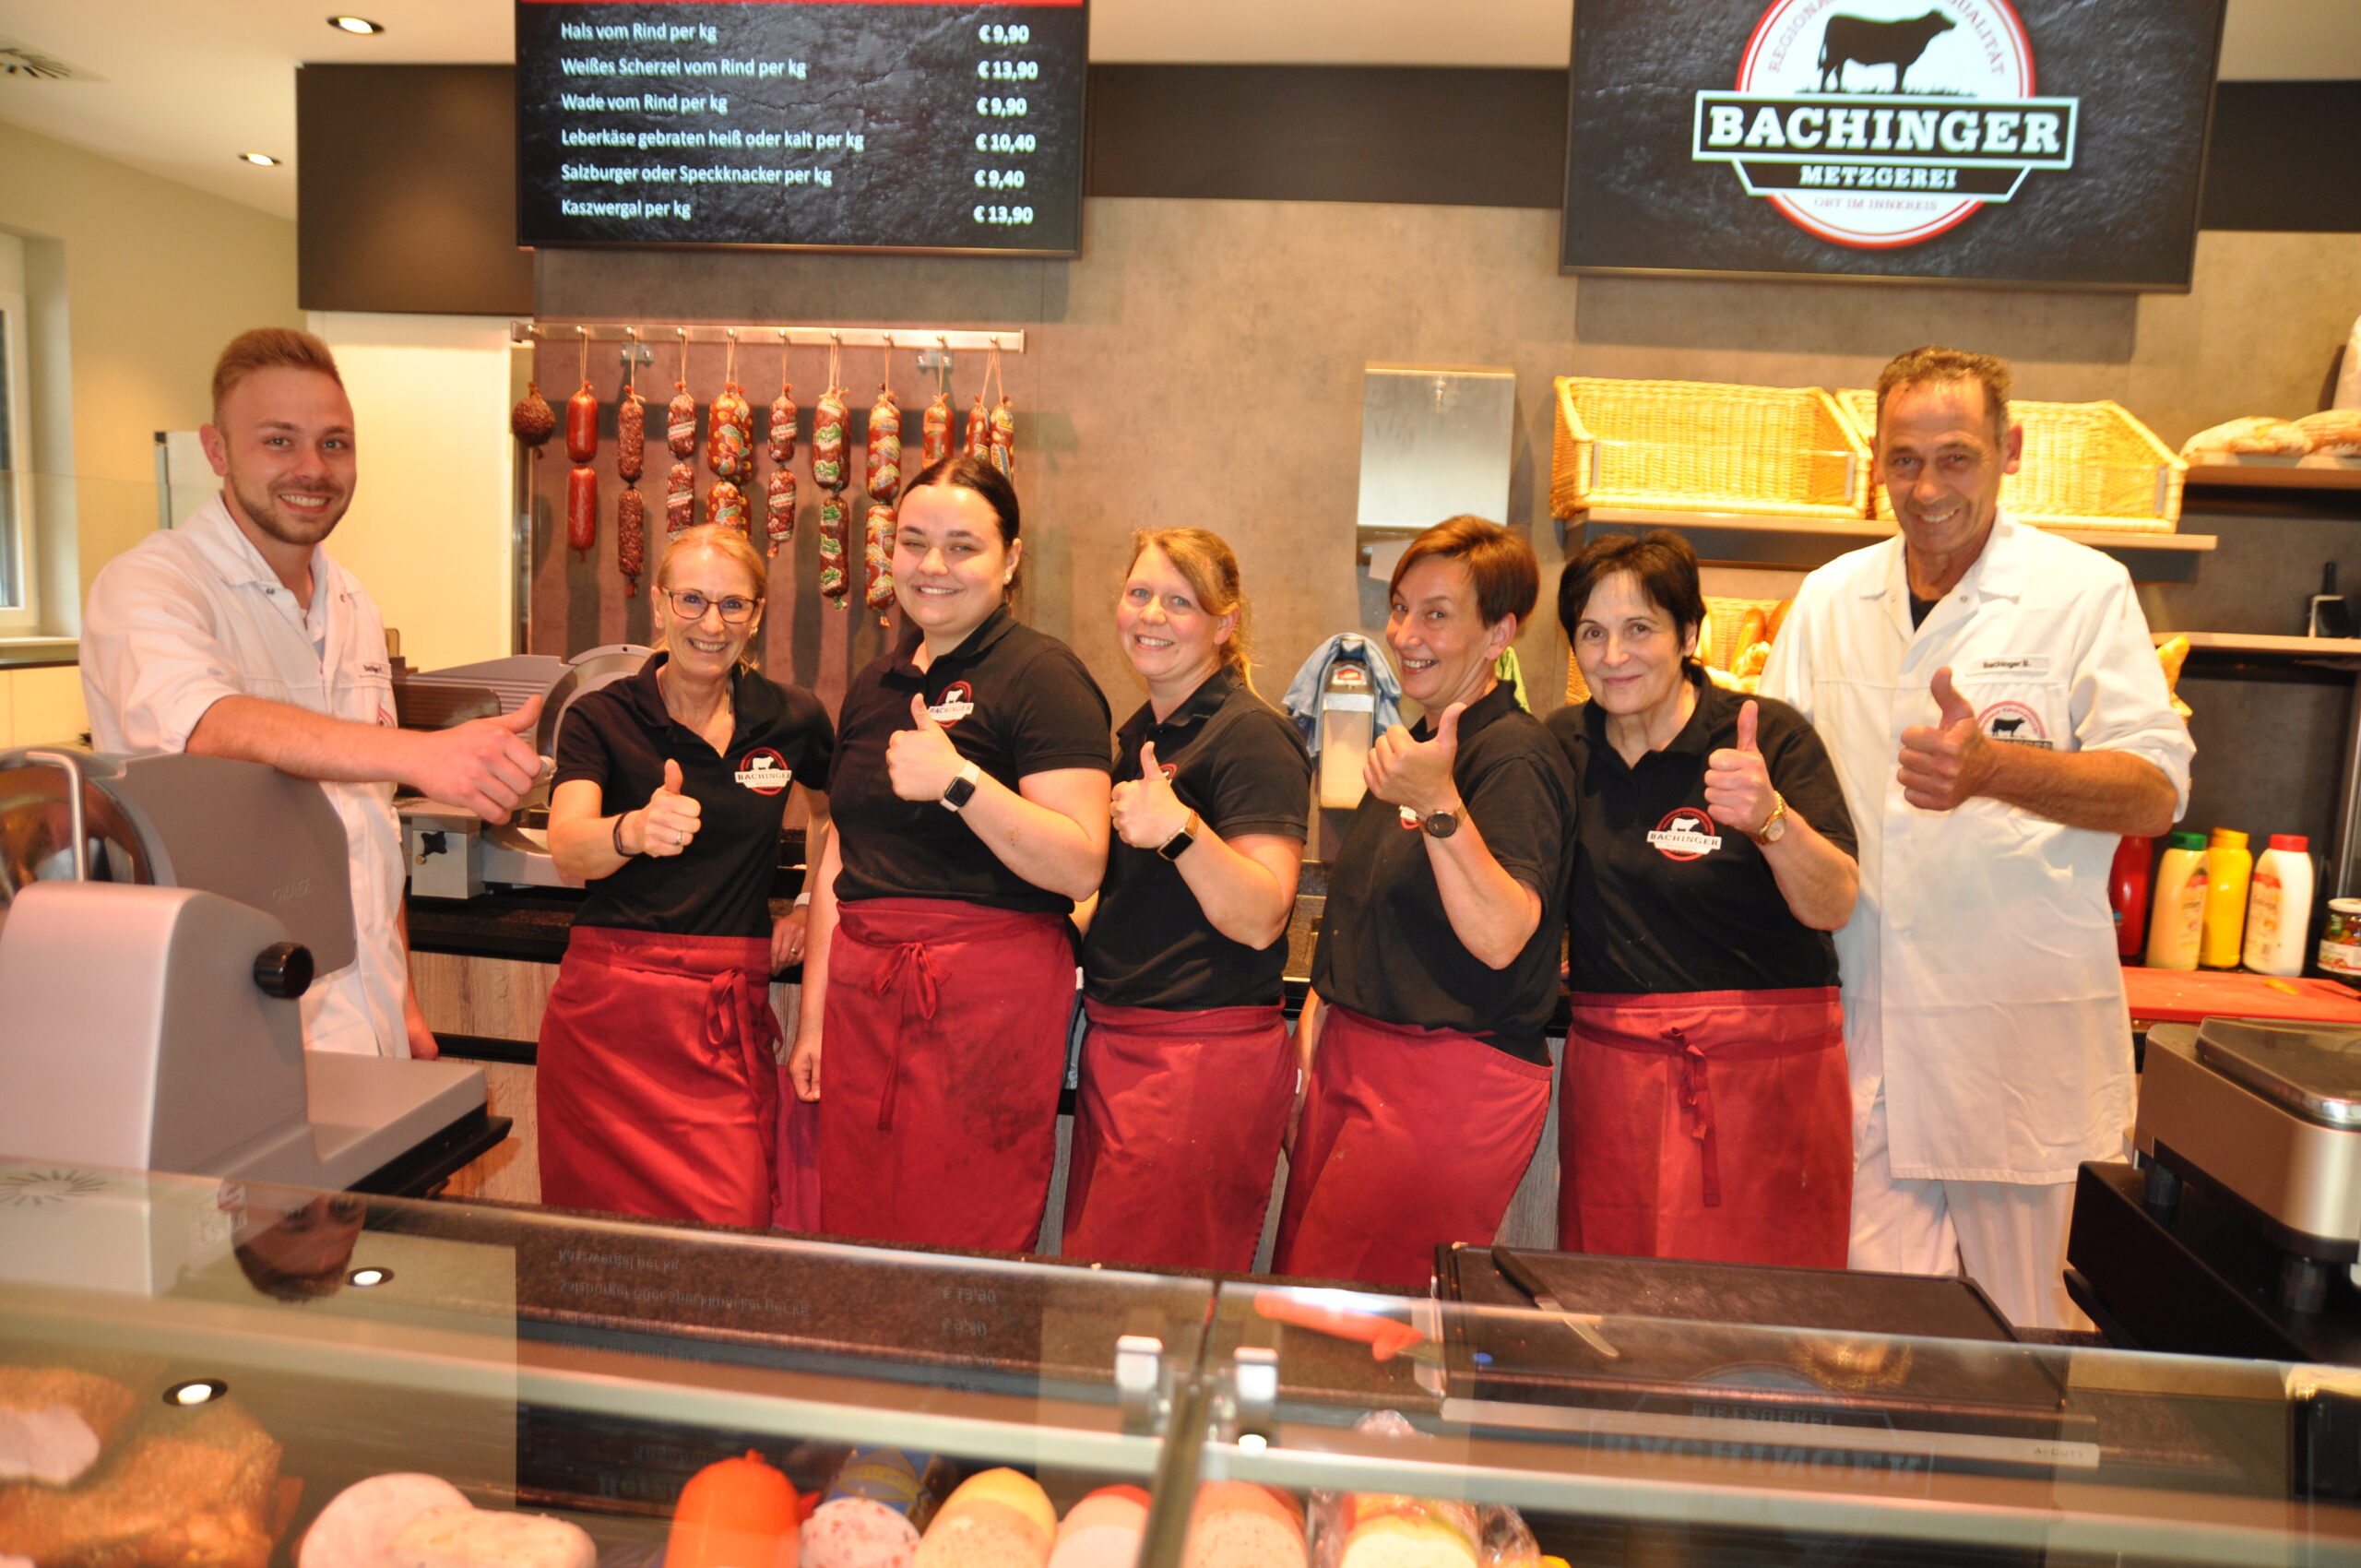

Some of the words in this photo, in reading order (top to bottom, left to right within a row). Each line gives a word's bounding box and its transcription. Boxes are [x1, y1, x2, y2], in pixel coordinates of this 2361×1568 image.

[561, 22, 593, 41] Hals
[596, 26, 629, 41] vom
[633, 22, 667, 41] Rind
[670, 25, 696, 44] per
[699, 22, 718, 44] kg
[979, 24, 991, 43] €
[992, 24, 1029, 46] 9,90
[561, 57, 616, 76] Weißes
[619, 58, 681, 76] Scherzel
[684, 62, 718, 76] vom
[721, 58, 754, 76] Rind
[758, 62, 785, 79] per
[788, 58, 807, 80] kg
[978, 60, 990, 80] €
[992, 61, 1038, 82] 13,90
[561, 93, 605, 112] Wade
[607, 97, 640, 112] vom
[644, 93, 678, 112] Rind
[681, 96, 706, 114] per
[709, 93, 728, 115] kg
[976, 97, 989, 116] €
[991, 97, 1027, 119] 9,90
[562, 128, 636, 147] Leberkäse
[637, 129, 706, 150] gebraten
[708, 129, 742, 148] heiß
[745, 129, 782, 148] oder
[784, 130, 813, 148] kalt
[816, 135, 843, 152] per
[846, 130, 865, 152] kg
[1707, 106, 2060, 154] BACHINGER
[975, 133, 988, 152] €
[990, 133, 1037, 155] 10,40
[561, 163, 638, 184] Salzburger
[642, 164, 677, 182] oder
[679, 165, 783, 186] Speckknacker
[784, 170, 811, 187] per
[813, 166, 832, 188] kg
[974, 169, 987, 188] €
[988, 170, 1025, 191] 9,40
[1799, 164, 1958, 190] METZGEREI
[562, 199, 642, 220] Kaszwergal
[646, 202, 670, 220] per
[673, 199, 692, 220] kg
[1814, 197, 1843, 208] ORT
[1846, 197, 1864, 208] IM
[973, 205, 986, 224] €
[988, 205, 1034, 227] 13,90
[1651, 833, 1718, 846] BACHINGER
